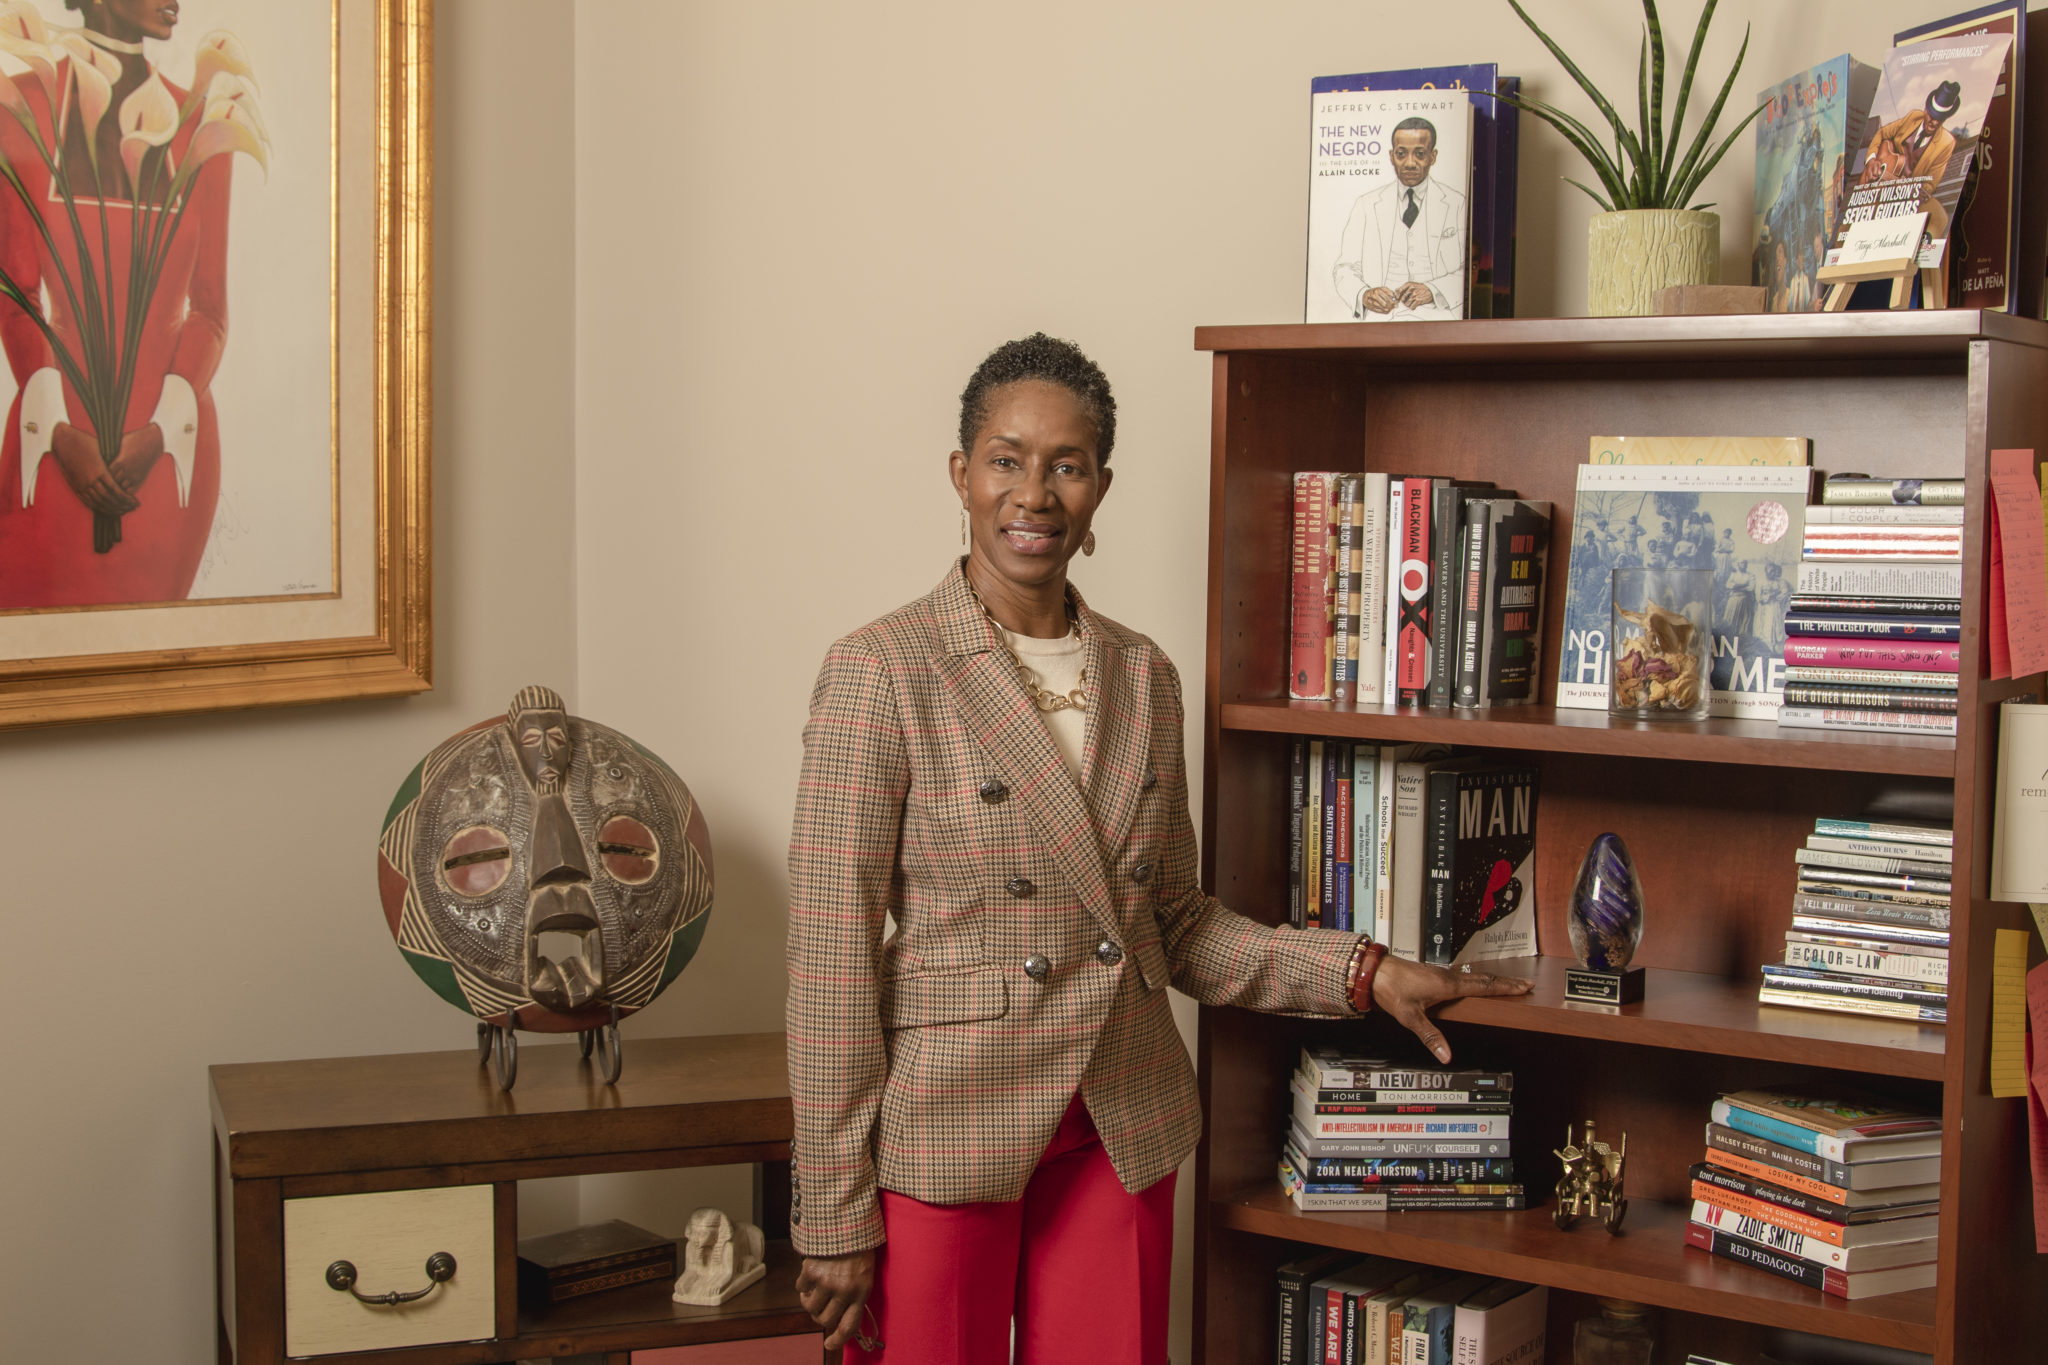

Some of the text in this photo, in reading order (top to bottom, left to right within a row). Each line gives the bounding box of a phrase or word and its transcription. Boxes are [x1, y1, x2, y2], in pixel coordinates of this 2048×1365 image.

[1321, 102, 1454, 112] JEFFREY C. STEWART
[1320, 125, 1382, 138] THE NEW
[1319, 142, 1381, 156] NEGRO
[1350, 168, 1380, 176] LOCKE
[1848, 184, 1922, 206] AUGUST WILSON'S
[1843, 200, 1920, 224] SEVEN GUITARS
[1962, 272, 2004, 292] DE LA PEÑA
[1294, 481, 1307, 573] THE BEGINNING
[1308, 482, 1322, 574] STAMPED FROM
[1410, 488, 1422, 554] BLACKMAN
[1340, 522, 1350, 544] BLACK
[1472, 524, 1482, 540] HOW
[1471, 541, 1482, 550] TO
[1471, 551, 1480, 560] BE
[1340, 546, 1350, 576] WOMEN'S
[1470, 560, 1480, 571] AN
[1364, 569, 1372, 589] HER
[1338, 578, 1348, 606] HISTORY
[1440, 588, 1448, 606] AND
[1468, 572, 1480, 612] ANTIRACIST
[1338, 607, 1348, 616] OF
[1362, 592, 1372, 642] PROPERTY
[1338, 618, 1348, 630] THE
[1466, 620, 1476, 643] IBRAM
[1800, 620, 1890, 634] THE PRIVILEGED POOR
[1336, 631, 1346, 654] UNITED
[1568, 630, 1605, 652] NO
[1438, 627, 1446, 678] UNIVERSITY
[1464, 652, 1475, 672] KENDI
[1796, 652, 1824, 660] PARKER
[1878, 652, 1896, 661] THIS
[1336, 656, 1346, 681] STATES
[1795, 668, 1903, 683] TONI MORRISON
[1361, 684, 1376, 692] Yale
[1791, 689, 1890, 707] THE OTHER MADISONS
[1823, 710, 1954, 726] WE WANT TO DO MORE THAN SURVIVE
[1400, 785, 1416, 793] Son
[1460, 774, 1532, 787] INVISIBLE
[1459, 786, 1531, 840] MAN
[1438, 799, 1446, 867] INVISIBLE
[1325, 805, 1334, 904] SHATTERING INEQUITIES
[1431, 868, 1450, 880] MAN
[1804, 899, 1820, 910] TELL
[1834, 902, 1856, 913] HORSE
[1484, 930, 1528, 944] Ralph Ellison
[1793, 946, 1882, 970] THE COLOR LAW
[1379, 1073, 1453, 1089] NEW BOY
[1332, 1092, 1360, 1101] HOME
[1384, 1093, 1406, 1101] TONI
[1322, 1122, 1424, 1133] ANTI-INTELLECTUALISM IN AMERICAN LIFE
[1436, 1144, 1479, 1153] YOURSELF
[1716, 1134, 1822, 1172] HALSEY STREET NAIMA COSTER
[1316, 1166, 1418, 1176] ZORA NEALE HURSTON
[1768, 1168, 1828, 1192] LOSING MY COOL
[1699, 1170, 1806, 1208] toni morrison playing in the dark
[1757, 1212, 1822, 1236] THE AMERICAN MIND
[1762, 1204, 1773, 1212] THE
[1776, 1208, 1807, 1224] CODDLING
[1706, 1204, 1804, 1255] NW ZADIE SMITH
[1730, 1242, 1806, 1278] RED PEDAGOGY
[1282, 1297, 1292, 1362] THE FAILURES
[1328, 1306, 1338, 1360] WE ARE
